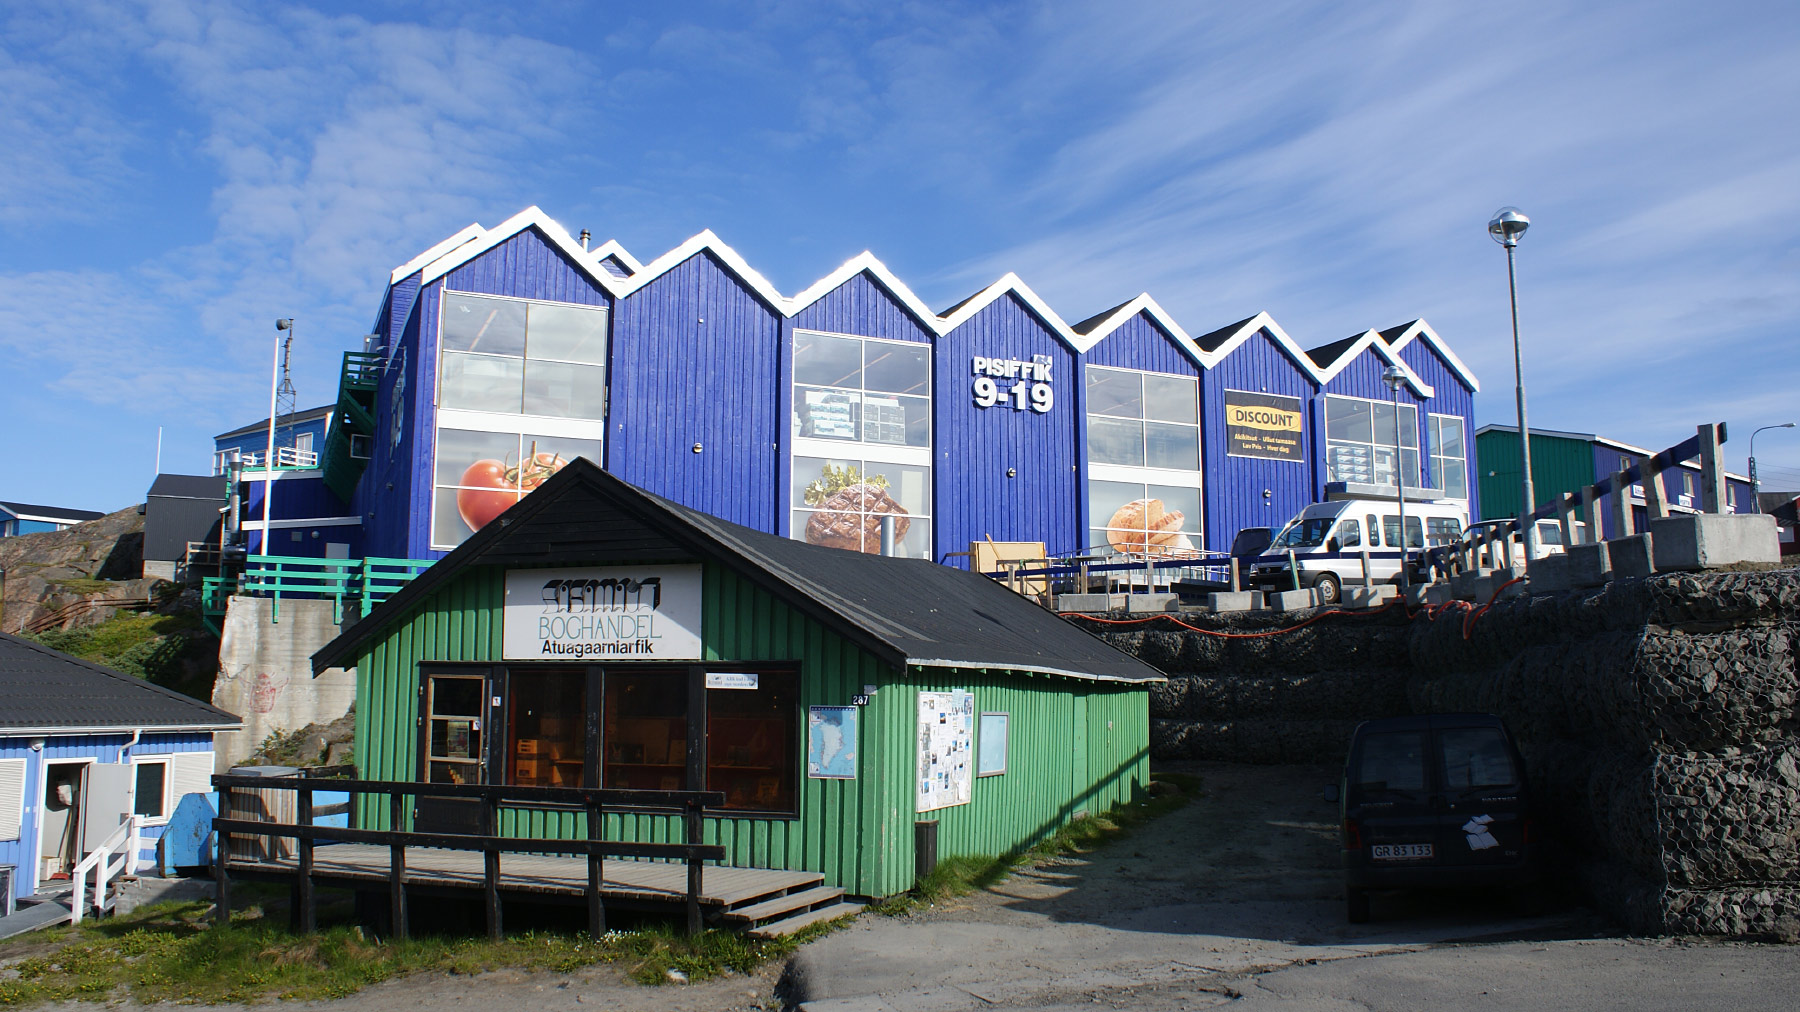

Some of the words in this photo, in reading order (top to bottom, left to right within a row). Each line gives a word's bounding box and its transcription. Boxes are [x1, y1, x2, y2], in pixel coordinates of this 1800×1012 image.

[974, 356, 1053, 382] PISIFFIK
[974, 377, 1054, 413] 9-19
[1236, 410, 1293, 426] DISCOUNT
[539, 615, 662, 640] BOGHANDEL
[542, 639, 654, 658] Atuagaarniarfik
[853, 695, 868, 705] 287
[1374, 846, 1390, 857] GR
[1393, 845, 1408, 857] 83
[1411, 845, 1431, 856] 133
